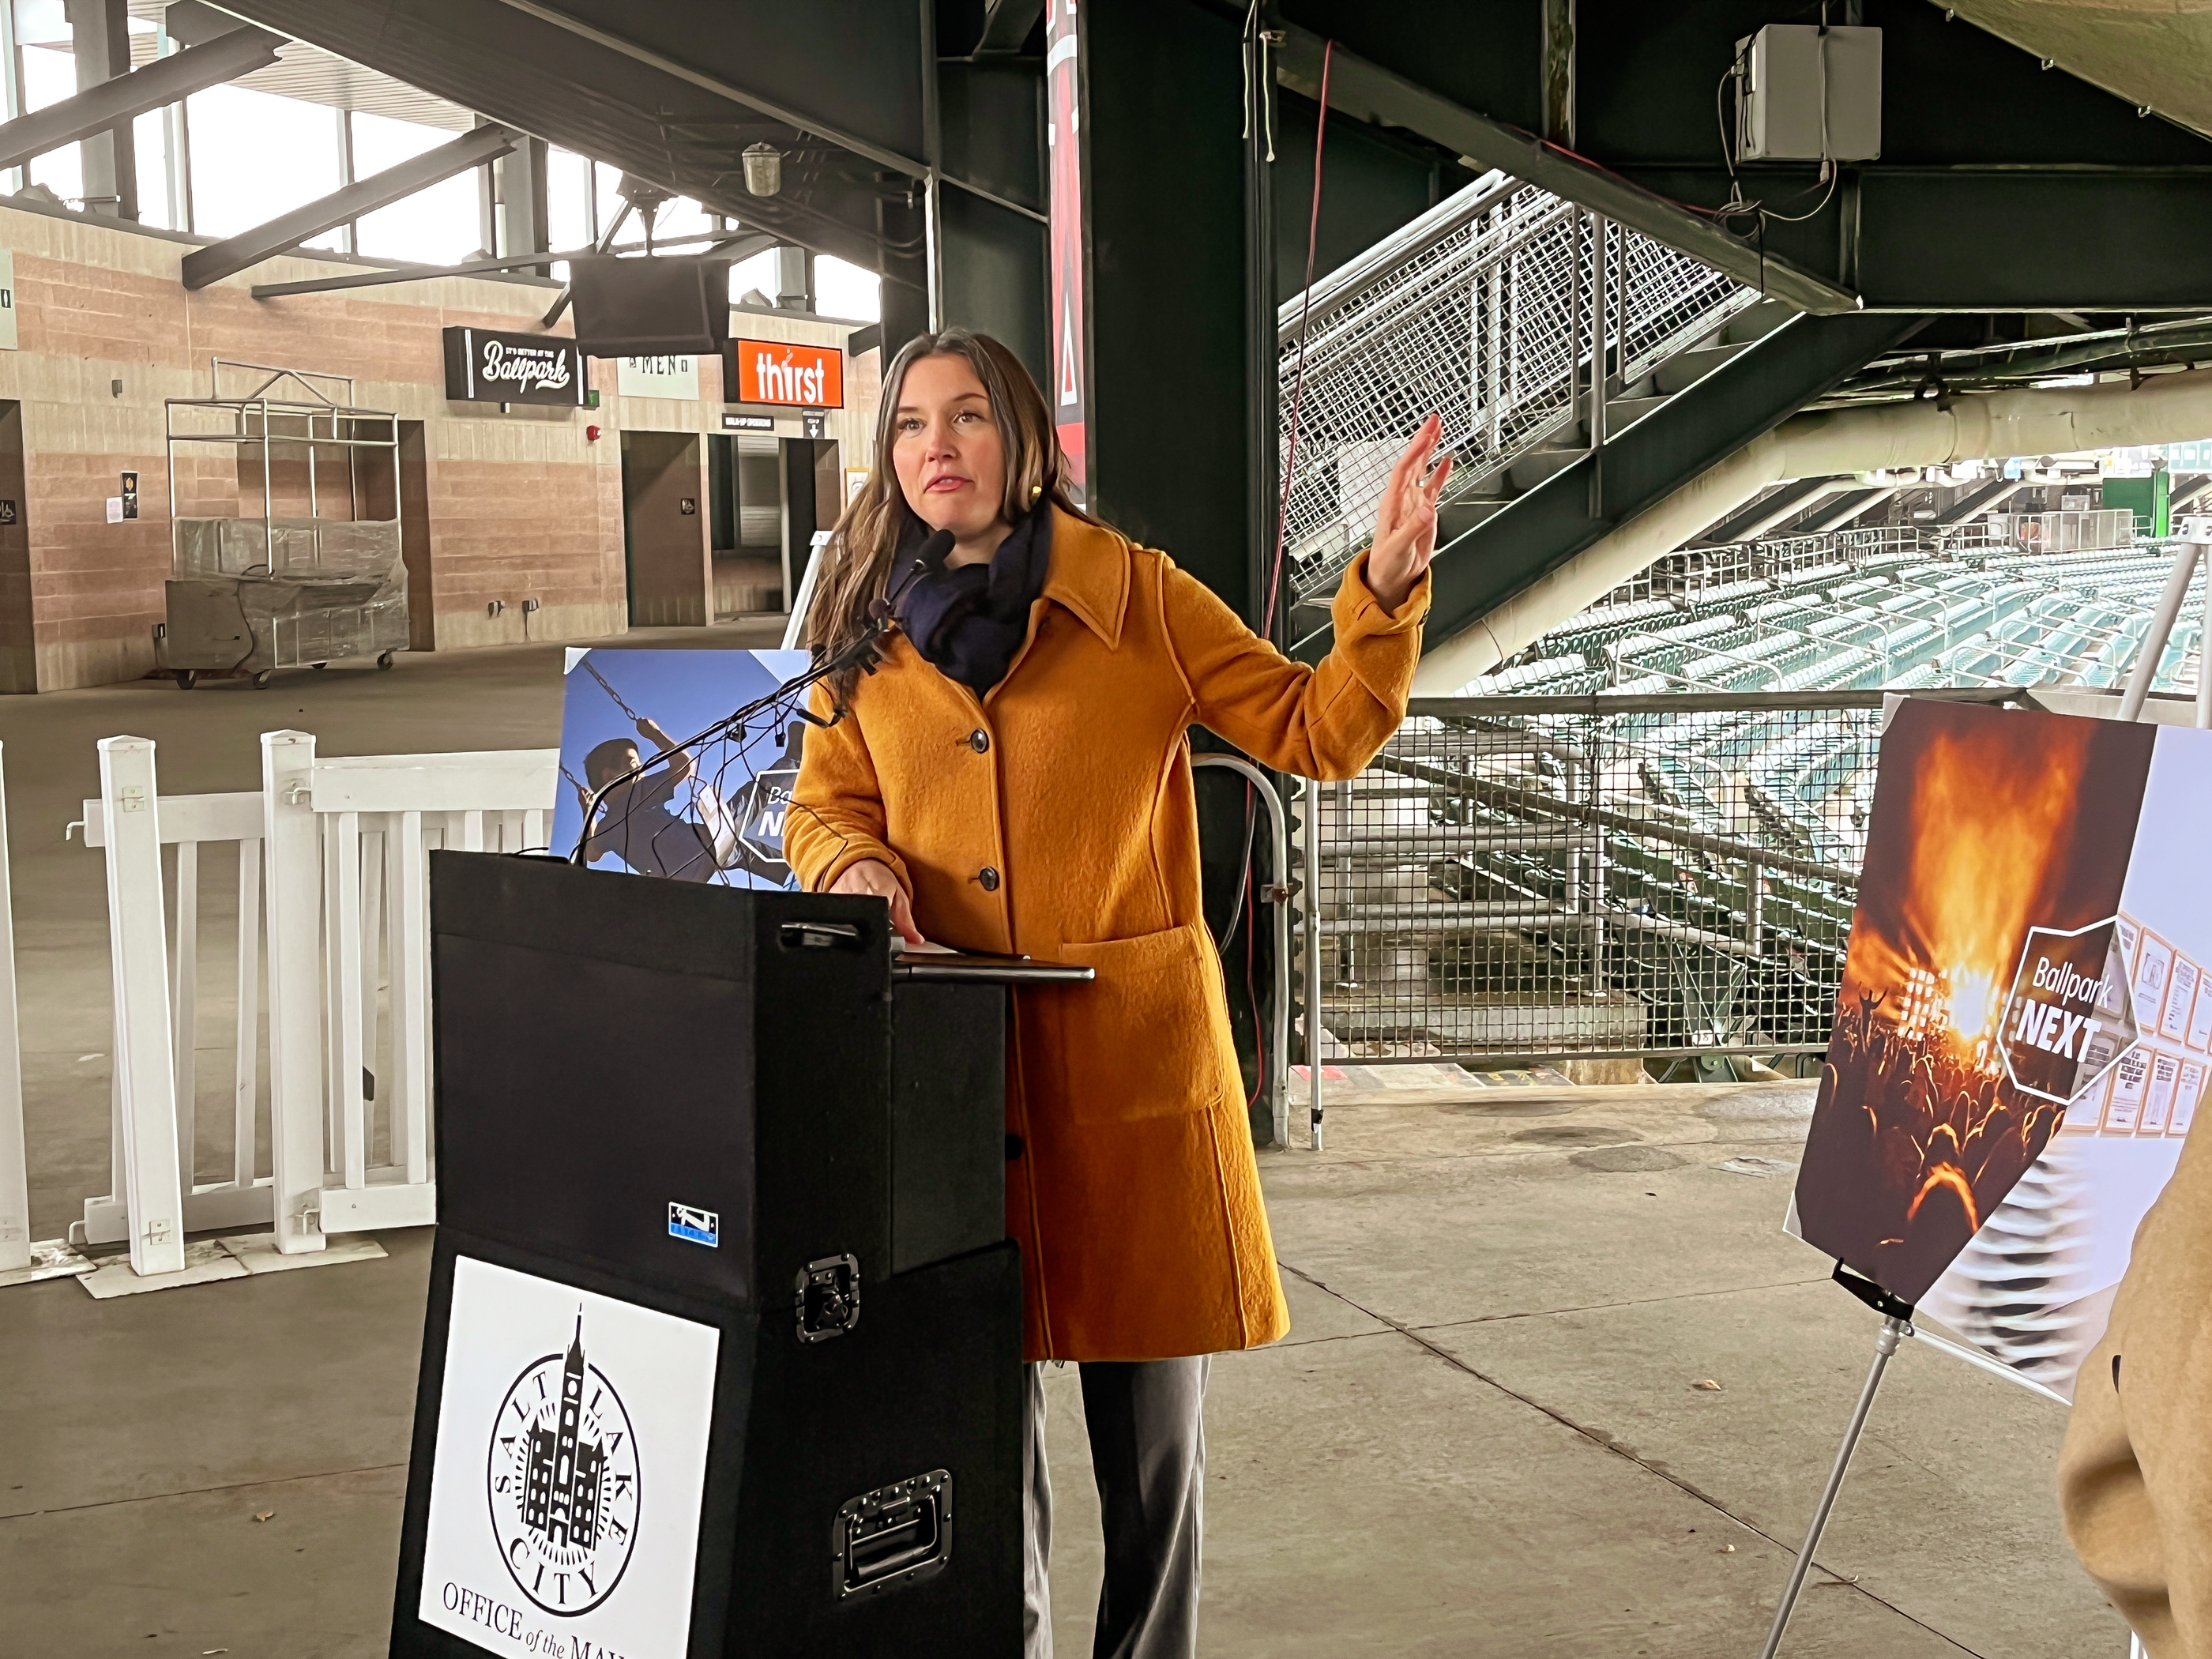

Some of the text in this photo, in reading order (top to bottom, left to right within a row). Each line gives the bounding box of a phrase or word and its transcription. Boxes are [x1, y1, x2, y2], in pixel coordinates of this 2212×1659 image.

[482, 340, 570, 394] Ballpark
[756, 348, 825, 404] thirst
[2032, 956, 2113, 1009] Ballpark
[2015, 999, 2102, 1063] NEXT
[495, 1371, 633, 1547] SALT LAKE
[510, 1537, 600, 1605] CITY
[443, 1582, 523, 1641] OFFICE
[525, 1629, 544, 1653] of
[543, 1634, 566, 1659] the
